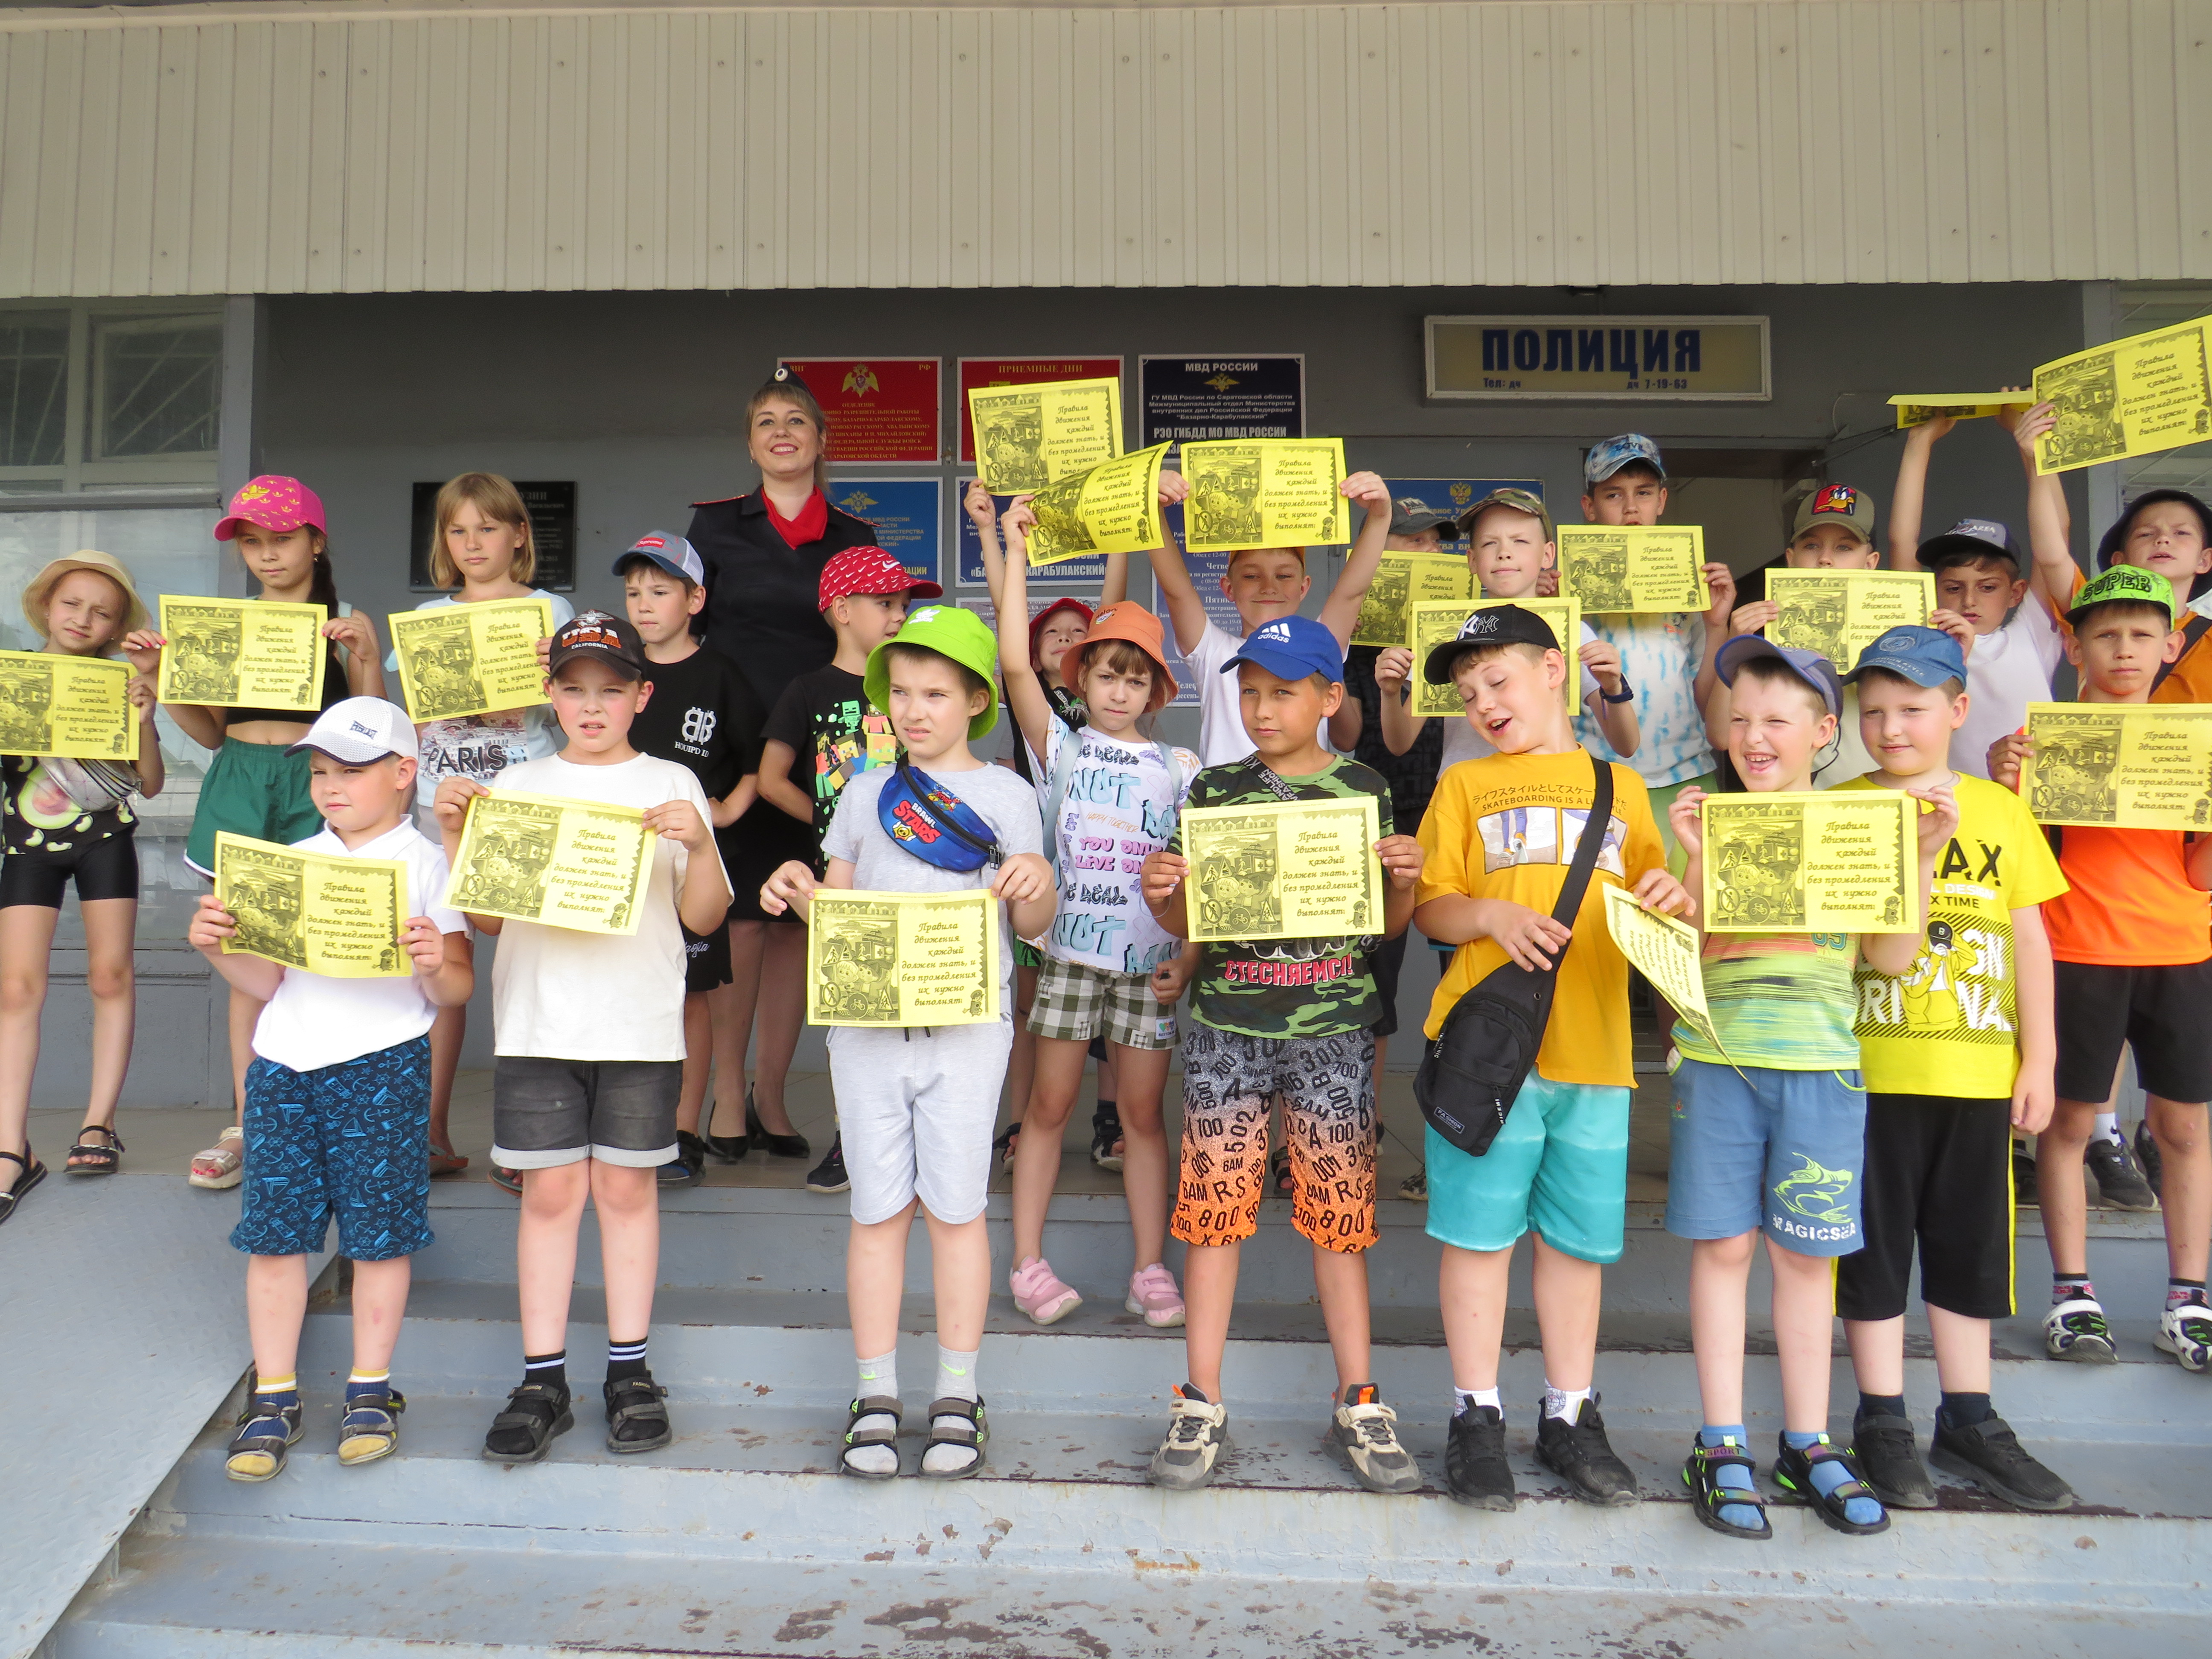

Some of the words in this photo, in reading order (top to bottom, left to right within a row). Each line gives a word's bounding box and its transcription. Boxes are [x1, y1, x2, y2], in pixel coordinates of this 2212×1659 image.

[1482, 329, 1700, 379] ПОЛИЦИЯ
[2135, 353, 2175, 369] Правила
[1185, 364, 1210, 373] МВД
[1213, 363, 1258, 371] РОССИИ
[2132, 364, 2177, 380] движения
[1484, 378, 1505, 387] Тел:
[1645, 379, 1688, 389] 7-19-63
[2146, 373, 2183, 388] каждый
[2122, 393, 2157, 406] должен
[2124, 408, 2137, 417] без
[2139, 393, 2199, 414] промедления
[2157, 408, 2187, 421] нужно
[1154, 428, 1172, 438] РЭО
[1174, 428, 1207, 439] ГИБДД
[1209, 428, 1222, 437] МО
[1225, 428, 1247, 438] МВД
[1249, 427, 1286, 437] РОССИИ
[1278, 460, 1311, 468] Правила
[1286, 478, 1317, 486] каждый
[1278, 499, 1327, 509] промедления
[1292, 512, 1317, 520] нужно
[2083, 572, 2152, 601] SUPER
[562, 626, 622, 649] USA
[1257, 633, 1289, 643] adidas
[428, 745, 507, 773] PARIS
[1069, 768, 1141, 809] NOT
[1482, 795, 1562, 811] SKATEBOARDING
[911, 802, 937, 828] BRAWL
[893, 800, 942, 844] STARS
[1086, 812, 1108, 823] HAPPY
[1109, 817, 1139, 833] TOGETHER
[1826, 821, 1870, 833] Правила
[1298, 831, 1338, 843] Правила
[1821, 835, 1872, 844] движения
[1079, 836, 1114, 852] YOU
[1121, 839, 1163, 856] ONLY
[1294, 845, 1340, 854] движения
[1836, 847, 1876, 859] каждый
[1308, 856, 1345, 867] каждый
[1807, 862, 1845, 870] должен
[1283, 871, 1317, 880] должен
[1807, 875, 1822, 884] без
[1825, 874, 1891, 886] промедления
[323, 882, 365, 893] Правила
[1283, 884, 1297, 893] без
[1299, 881, 1359, 894] промедления
[1945, 884, 1995, 900] DESIGN
[320, 893, 367, 905] движения
[1316, 896, 1346, 905] нужно
[1825, 891, 1838, 899] их
[1843, 891, 1877, 899] нужно
[1944, 896, 1979, 908] TIME
[334, 908, 372, 916] каждый
[307, 914, 342, 926] должен
[307, 926, 322, 935] без
[324, 930, 386, 939] промедления
[918, 922, 958, 933] Правила
[914, 935, 959, 944] движения
[1054, 913, 1126, 955] NOT
[928, 946, 963, 957] каждый
[902, 960, 936, 969] должен
[902, 973, 916, 982] без
[918, 971, 976, 984] промедления
[934, 986, 964, 995] нужно
[1299, 1039, 1343, 1073] 300
[1333, 1061, 1359, 1078] 700
[1328, 1086, 1355, 1121] 500
[1438, 1109, 1461, 1129] FASHION
[1198, 1118, 1223, 1138] 100
[1223, 1157, 1243, 1172] 6AM
[1199, 1206, 1239, 1231] 800
[1773, 1213, 1856, 1241] MAGICSEA
